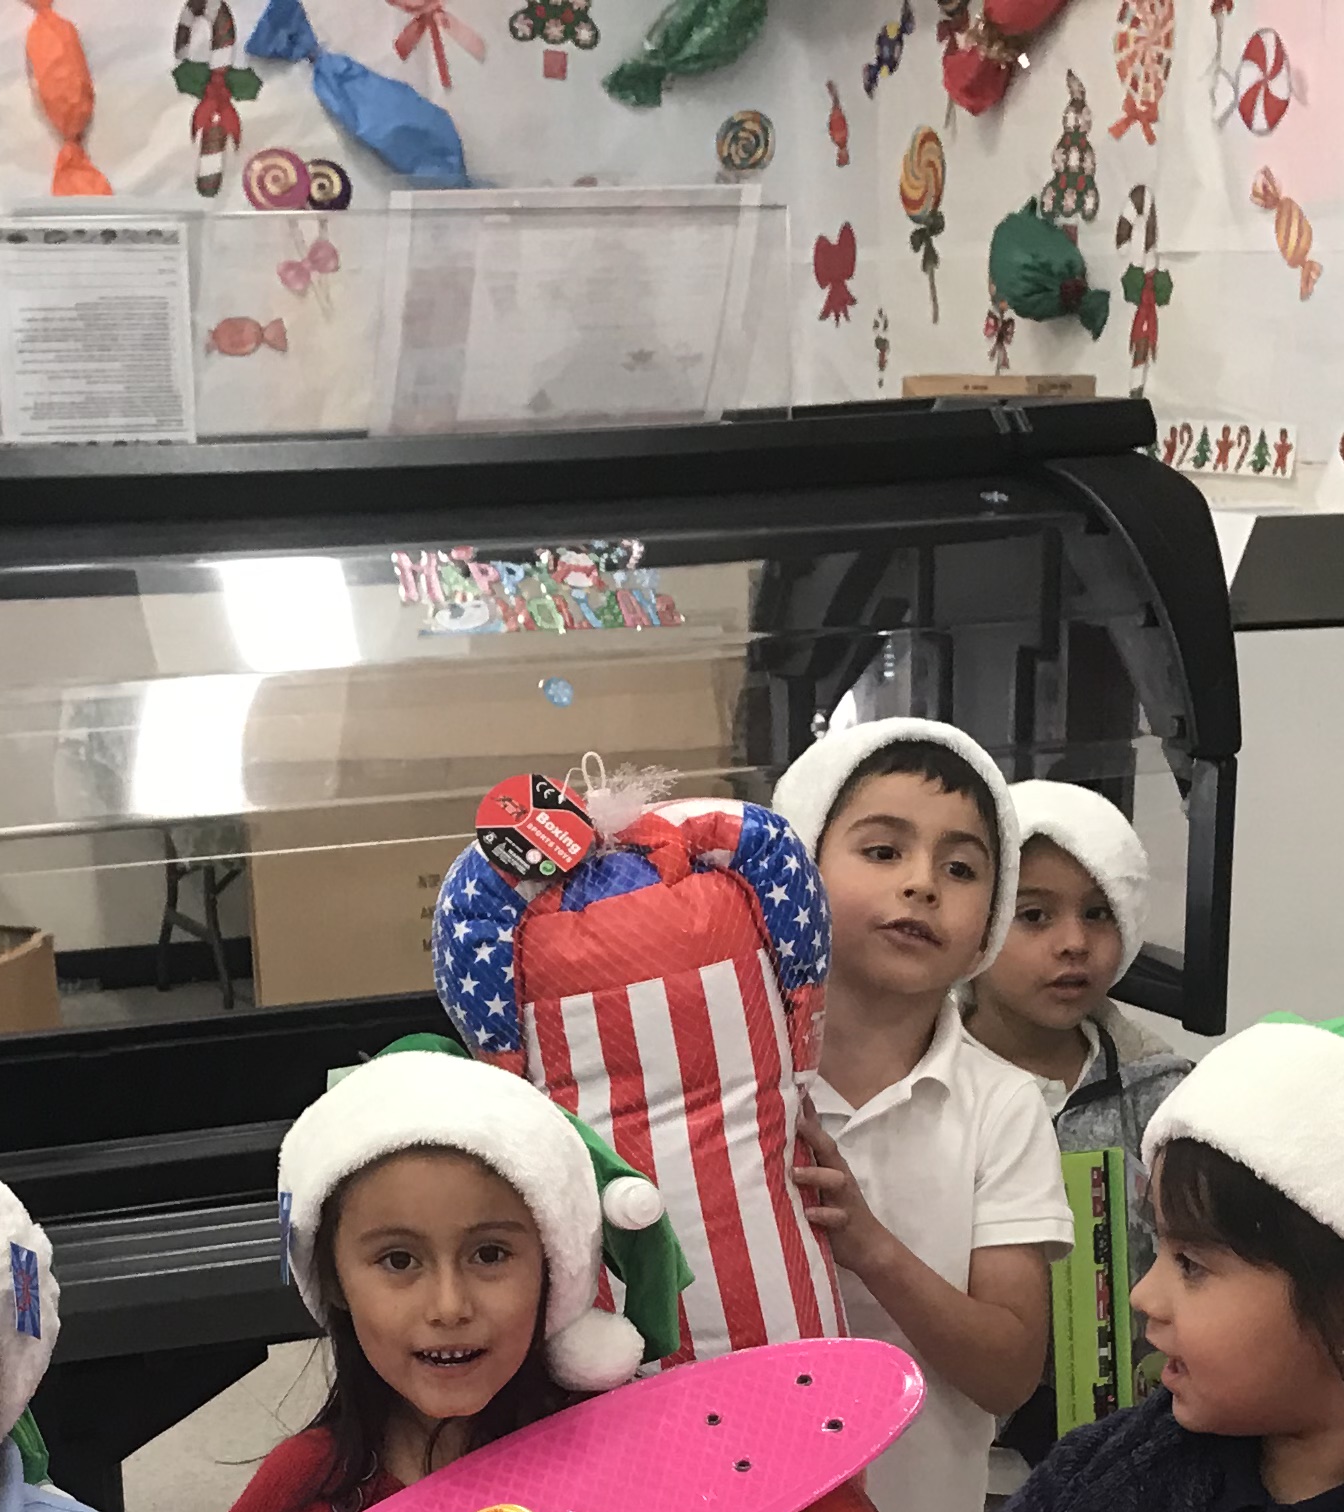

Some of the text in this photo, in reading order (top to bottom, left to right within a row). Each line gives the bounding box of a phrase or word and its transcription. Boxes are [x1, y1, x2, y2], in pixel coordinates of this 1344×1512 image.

[526, 822, 556, 848] SPORTS
[554, 845, 573, 863] TOYS
[536, 811, 582, 855] Boxing
